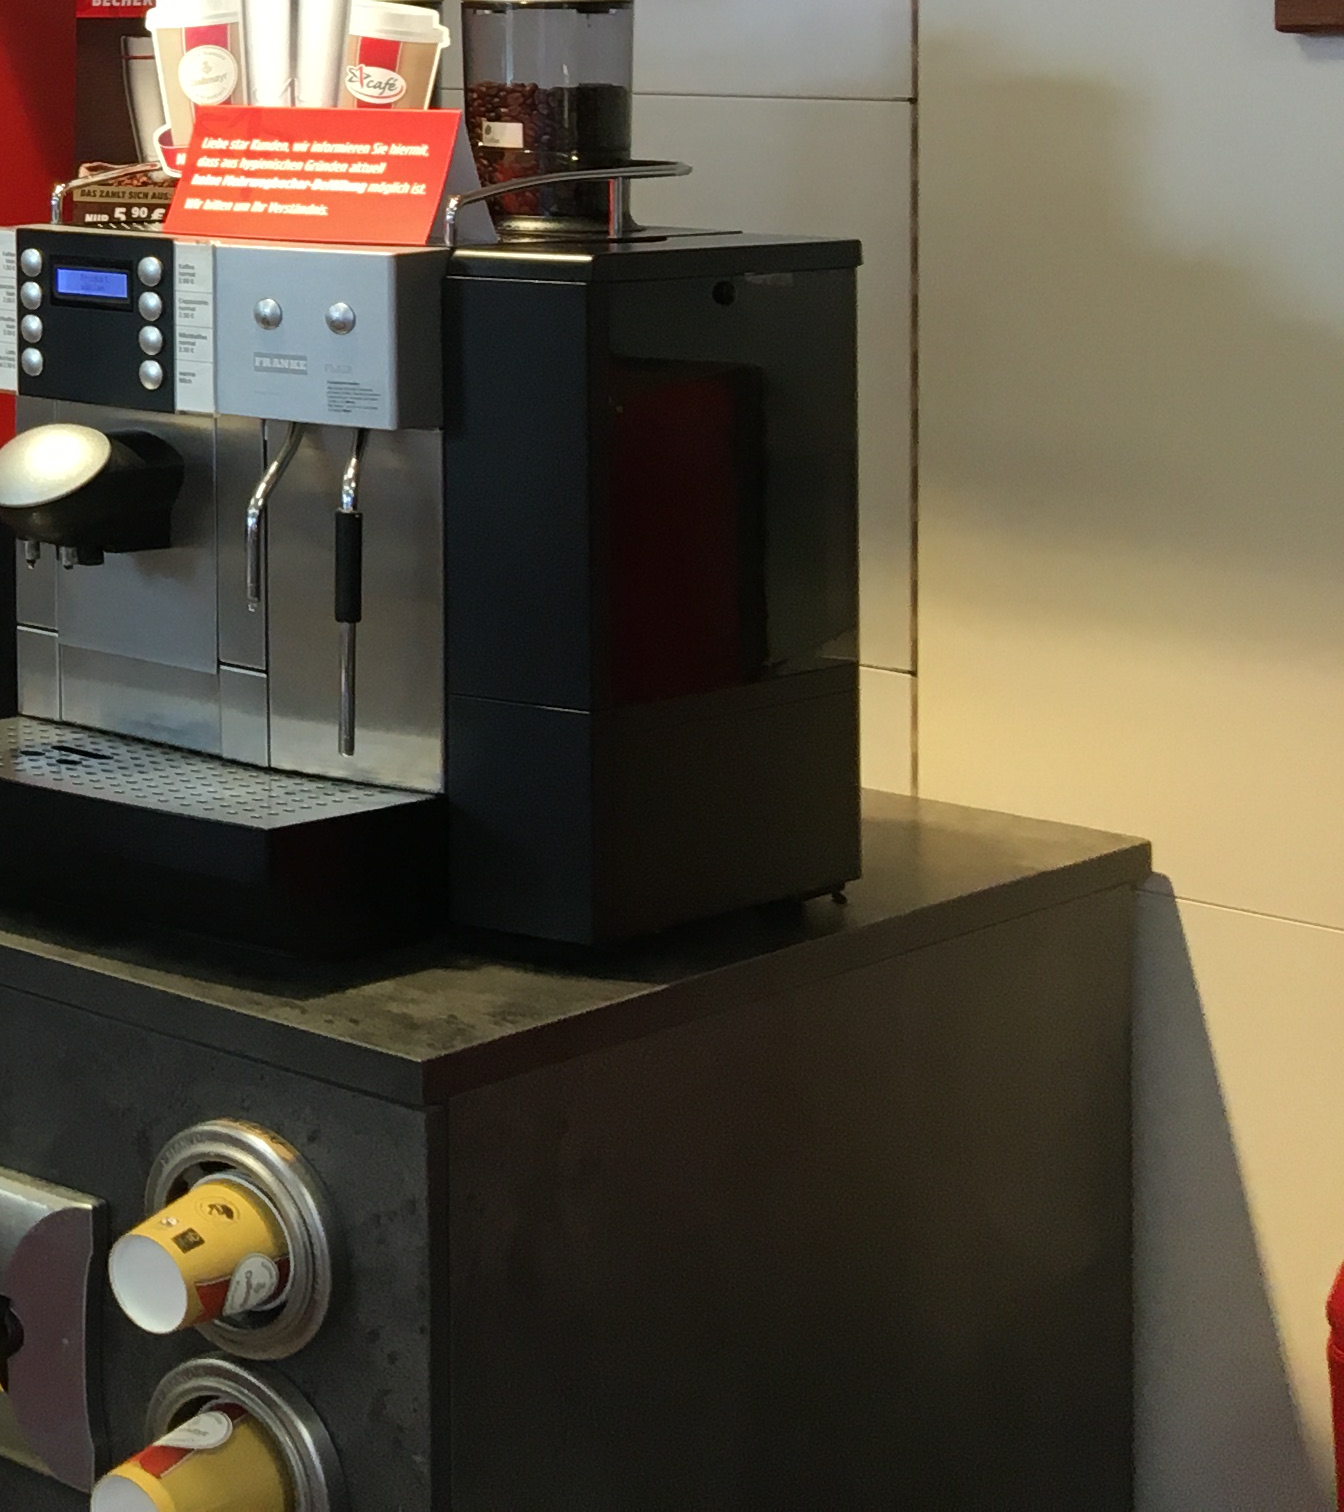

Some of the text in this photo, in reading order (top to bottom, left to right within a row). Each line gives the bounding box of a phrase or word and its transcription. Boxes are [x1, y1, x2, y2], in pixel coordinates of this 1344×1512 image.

[366, 77, 399, 95] café
[201, 137, 229, 150] Liebe
[292, 141, 310, 153] wir
[310, 140, 371, 154] informieren
[371, 142, 388, 155] Sie
[196, 156, 219, 169] dass
[220, 158, 239, 169] aus
[349, 161, 388, 175] aktuell
[80, 189, 97, 198] DAS
[99, 189, 126, 199] ZAHLT
[128, 190, 149, 200] SICH
[368, 180, 411, 195] möglich
[254, 356, 307, 370] FRANKE
